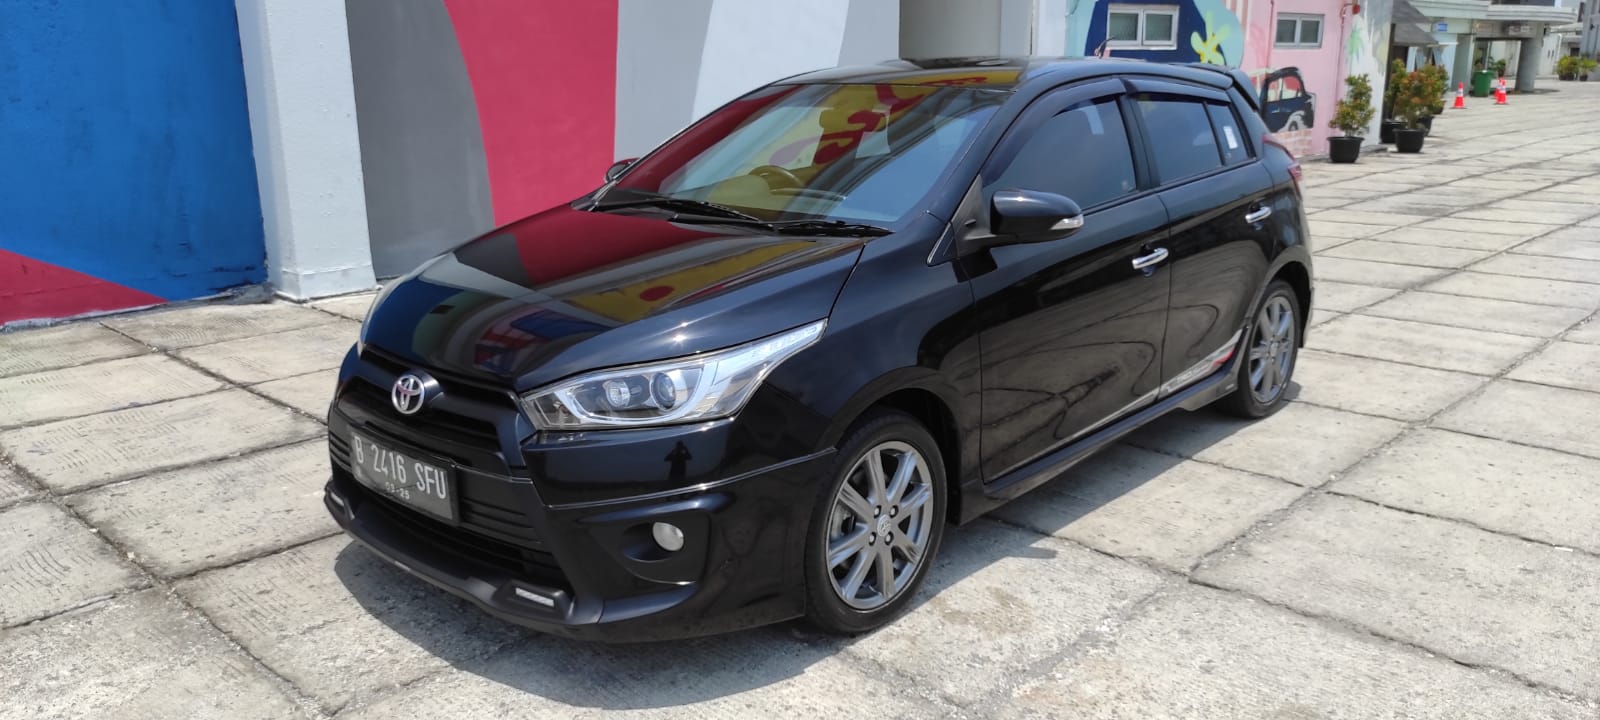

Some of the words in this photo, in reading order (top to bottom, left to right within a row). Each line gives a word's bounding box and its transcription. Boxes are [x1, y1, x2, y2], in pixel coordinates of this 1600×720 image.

[353, 435, 364, 464] B
[371, 444, 407, 484] 2416
[414, 462, 446, 499] SFU
